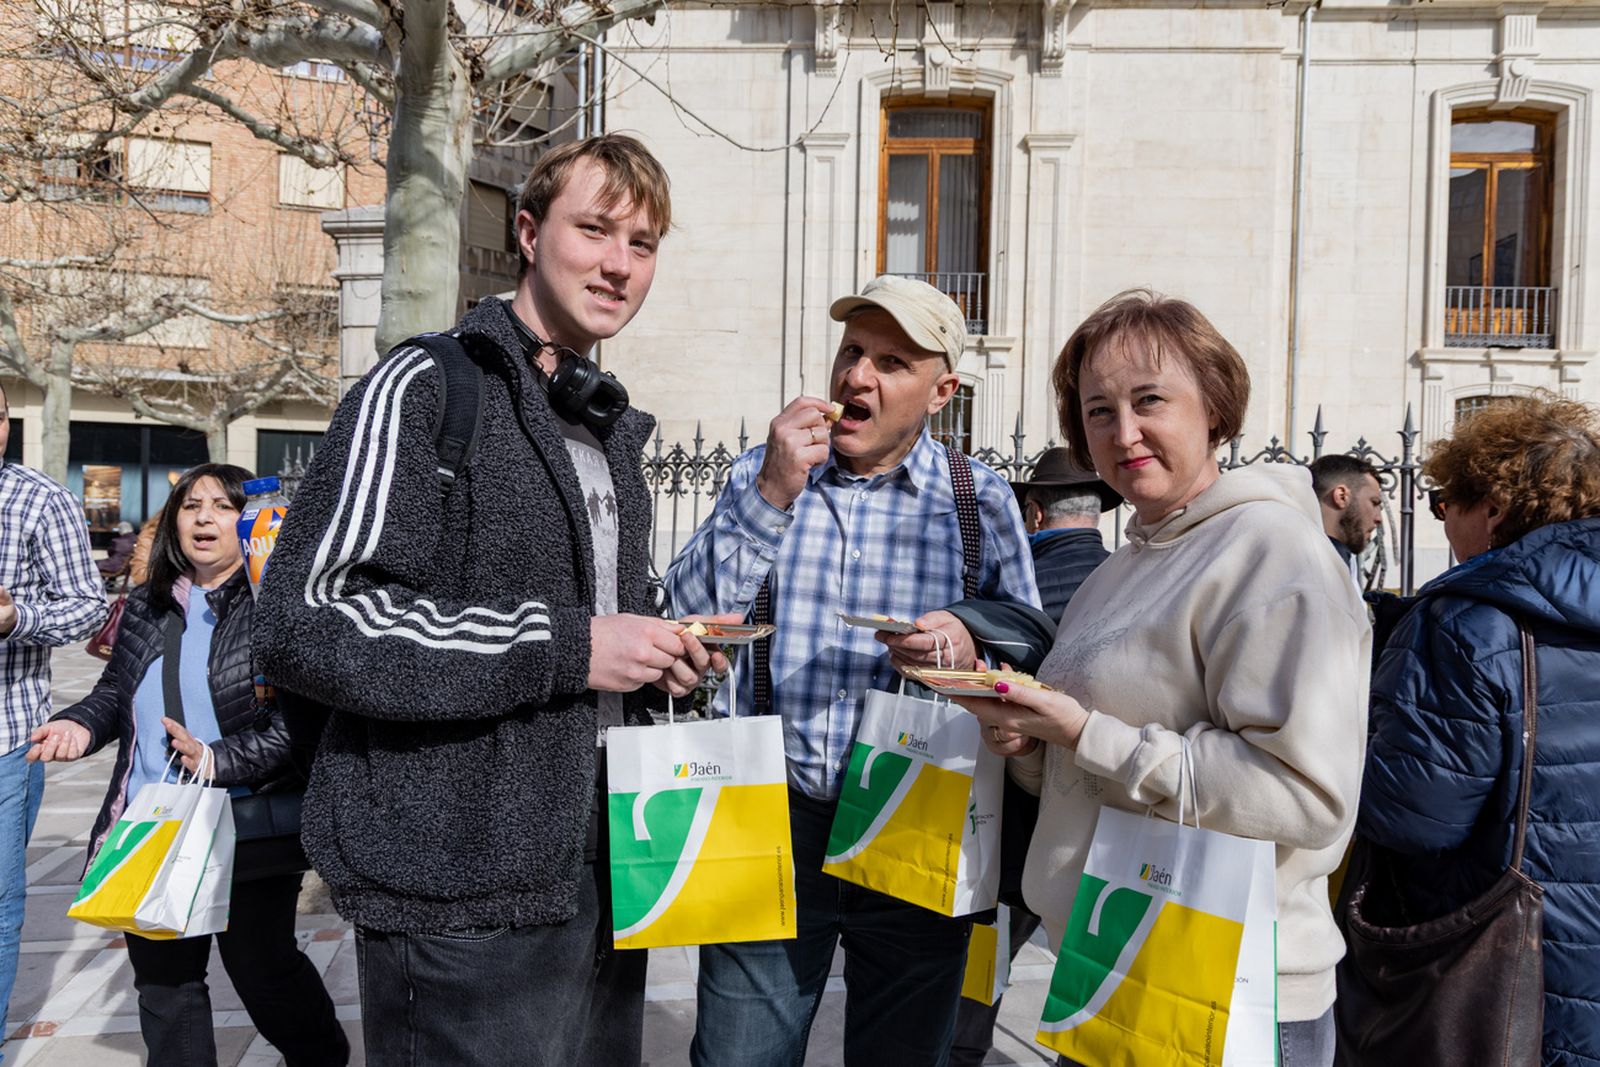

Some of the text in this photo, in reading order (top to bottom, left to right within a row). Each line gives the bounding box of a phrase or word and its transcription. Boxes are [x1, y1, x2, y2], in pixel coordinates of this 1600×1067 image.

[908, 733, 929, 752] Jaén
[690, 761, 721, 777] Jaén
[1149, 864, 1172, 886] Jaén
